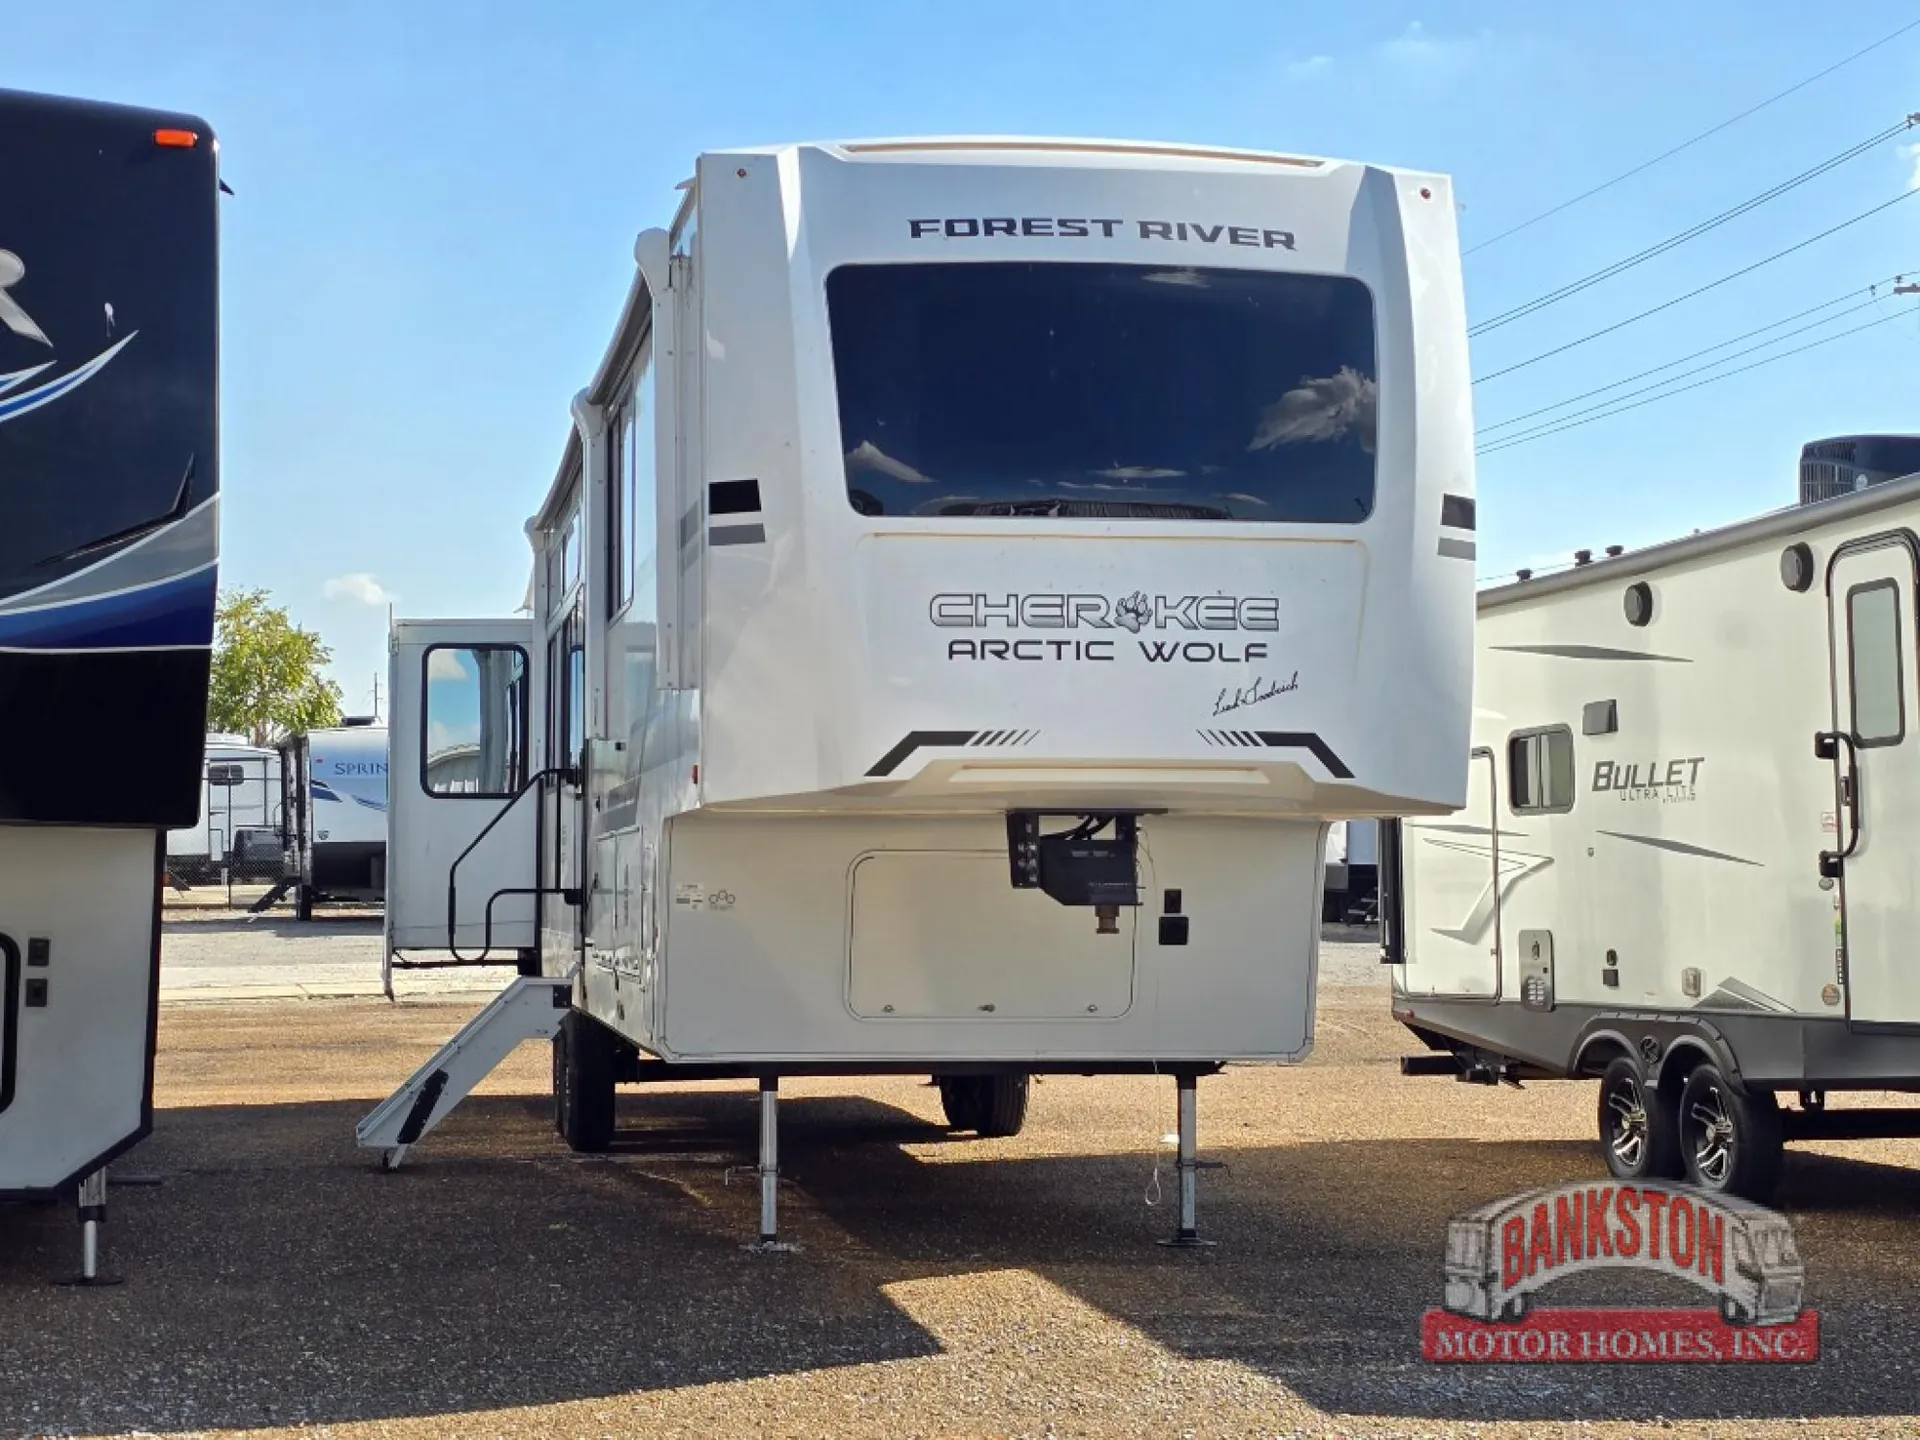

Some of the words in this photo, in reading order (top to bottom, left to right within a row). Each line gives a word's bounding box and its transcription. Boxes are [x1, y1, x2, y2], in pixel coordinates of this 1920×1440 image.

[909, 217, 1124, 239] FOREST
[1136, 220, 1298, 251] RIVER
[948, 639, 1115, 661] ARCTIC
[1138, 641, 1268, 663] WOLF
[1591, 757, 1705, 792] BULLET
